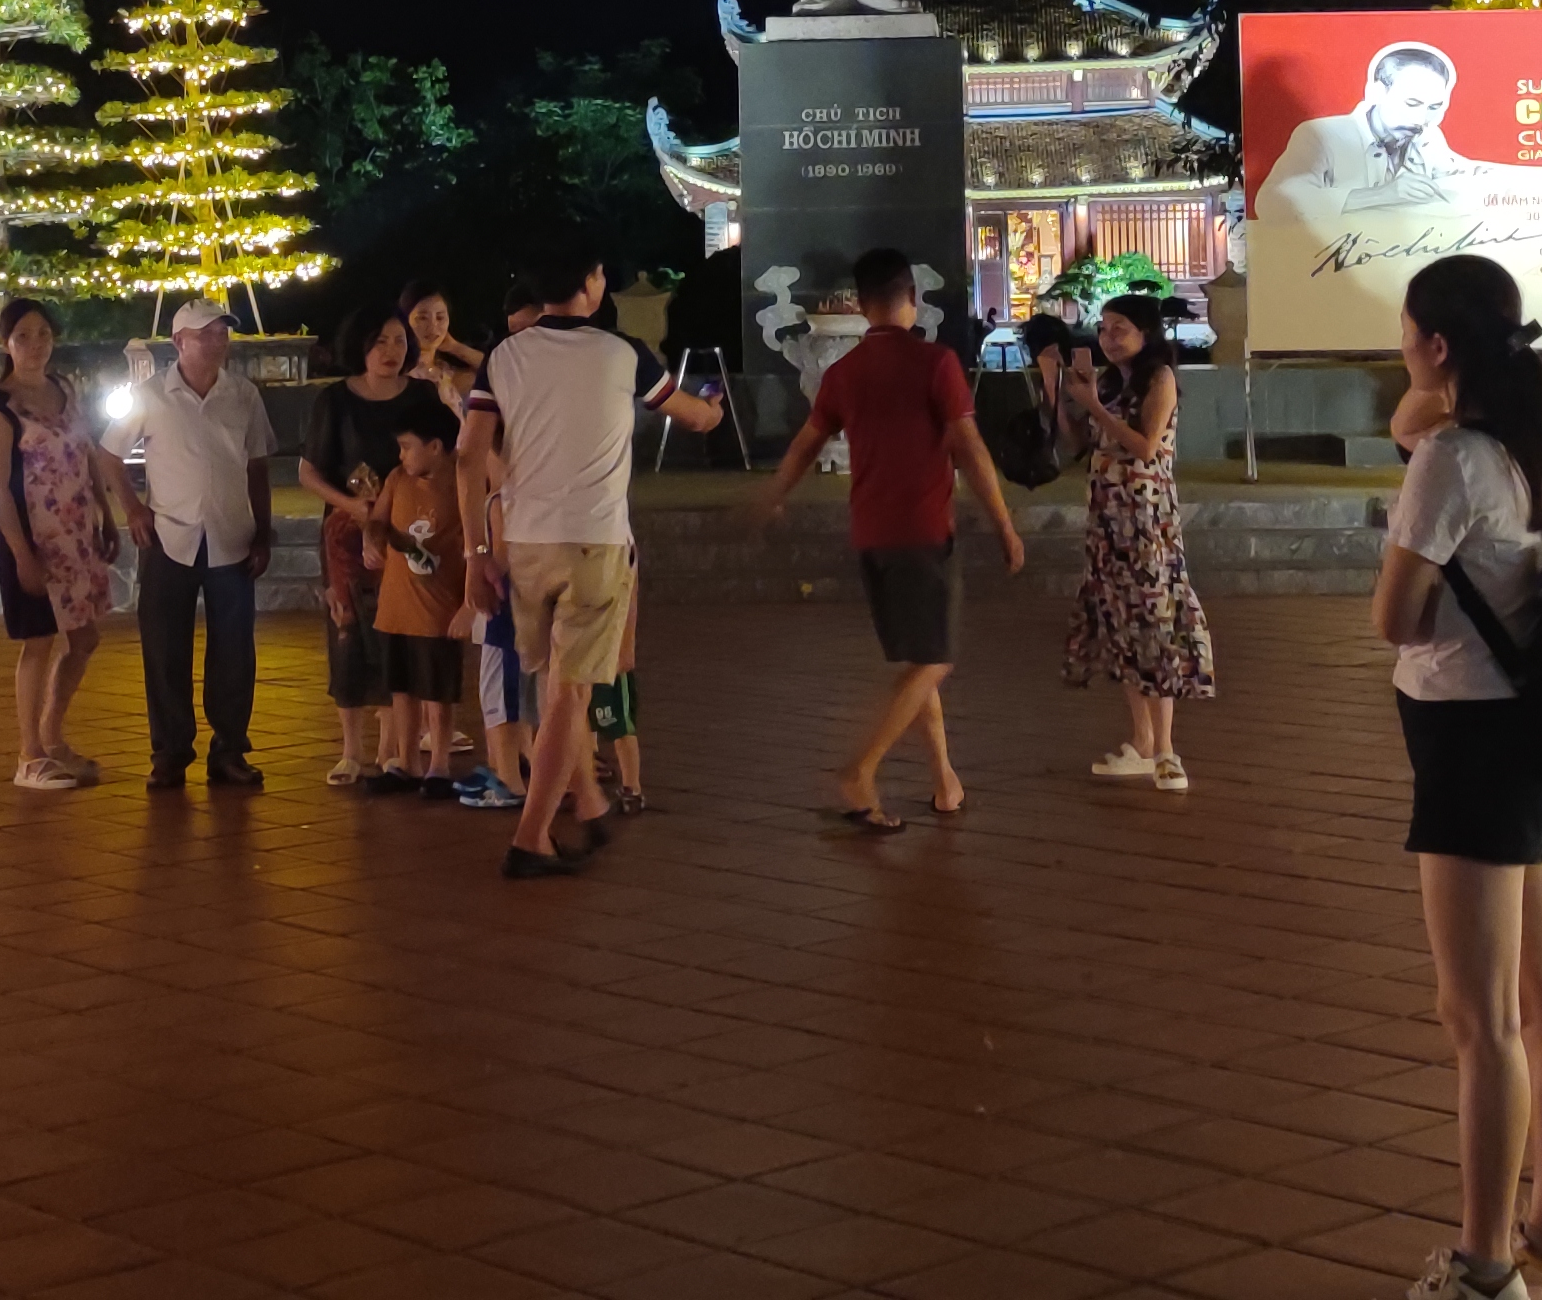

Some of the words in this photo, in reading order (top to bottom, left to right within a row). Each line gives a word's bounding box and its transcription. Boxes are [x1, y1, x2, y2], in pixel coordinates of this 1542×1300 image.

[801, 103, 842, 122] CHỦ
[816, 124, 858, 150] CHÍ
[860, 127, 922, 149] MINH
